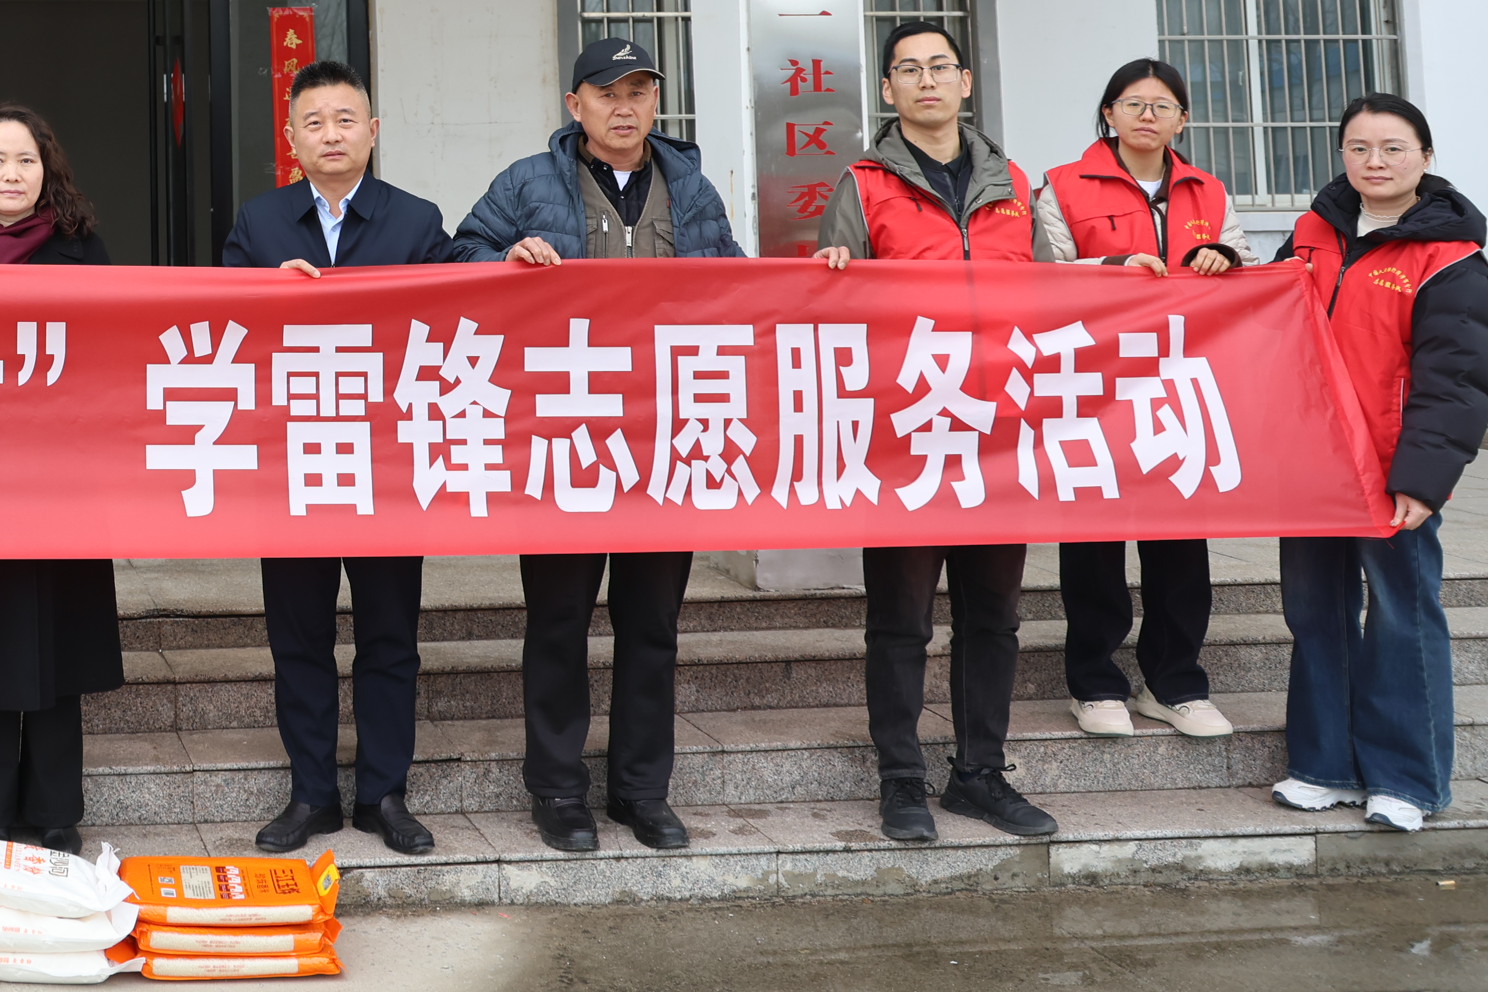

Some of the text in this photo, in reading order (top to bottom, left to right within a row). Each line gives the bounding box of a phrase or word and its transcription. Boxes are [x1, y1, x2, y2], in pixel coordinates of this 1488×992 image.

[145, 314, 1242, 517] 学雷锋志愿服务活动
